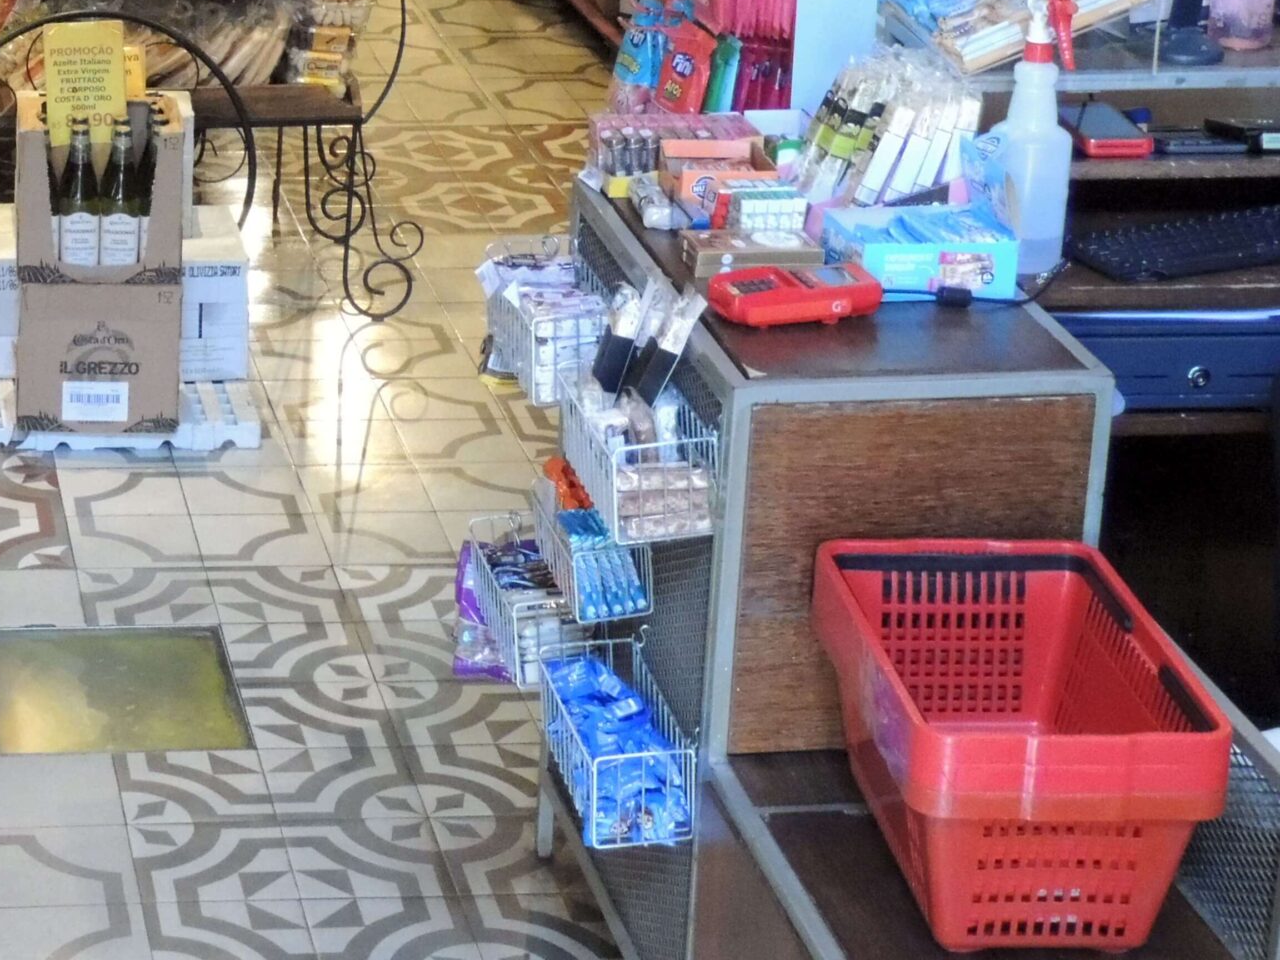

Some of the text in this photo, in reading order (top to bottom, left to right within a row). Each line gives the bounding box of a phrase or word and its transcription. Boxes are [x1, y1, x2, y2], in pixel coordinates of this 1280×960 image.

[50, 47, 113, 57] PROMOÇÃO
[80, 58, 112, 66] Italiano
[81, 67, 110, 76] Virgem
[61, 76, 105, 84] FRUTTADO
[54, 95, 82, 103] COSTA
[65, 112, 114, 129] 8,90
[75, 361, 140, 376] GREZZO
